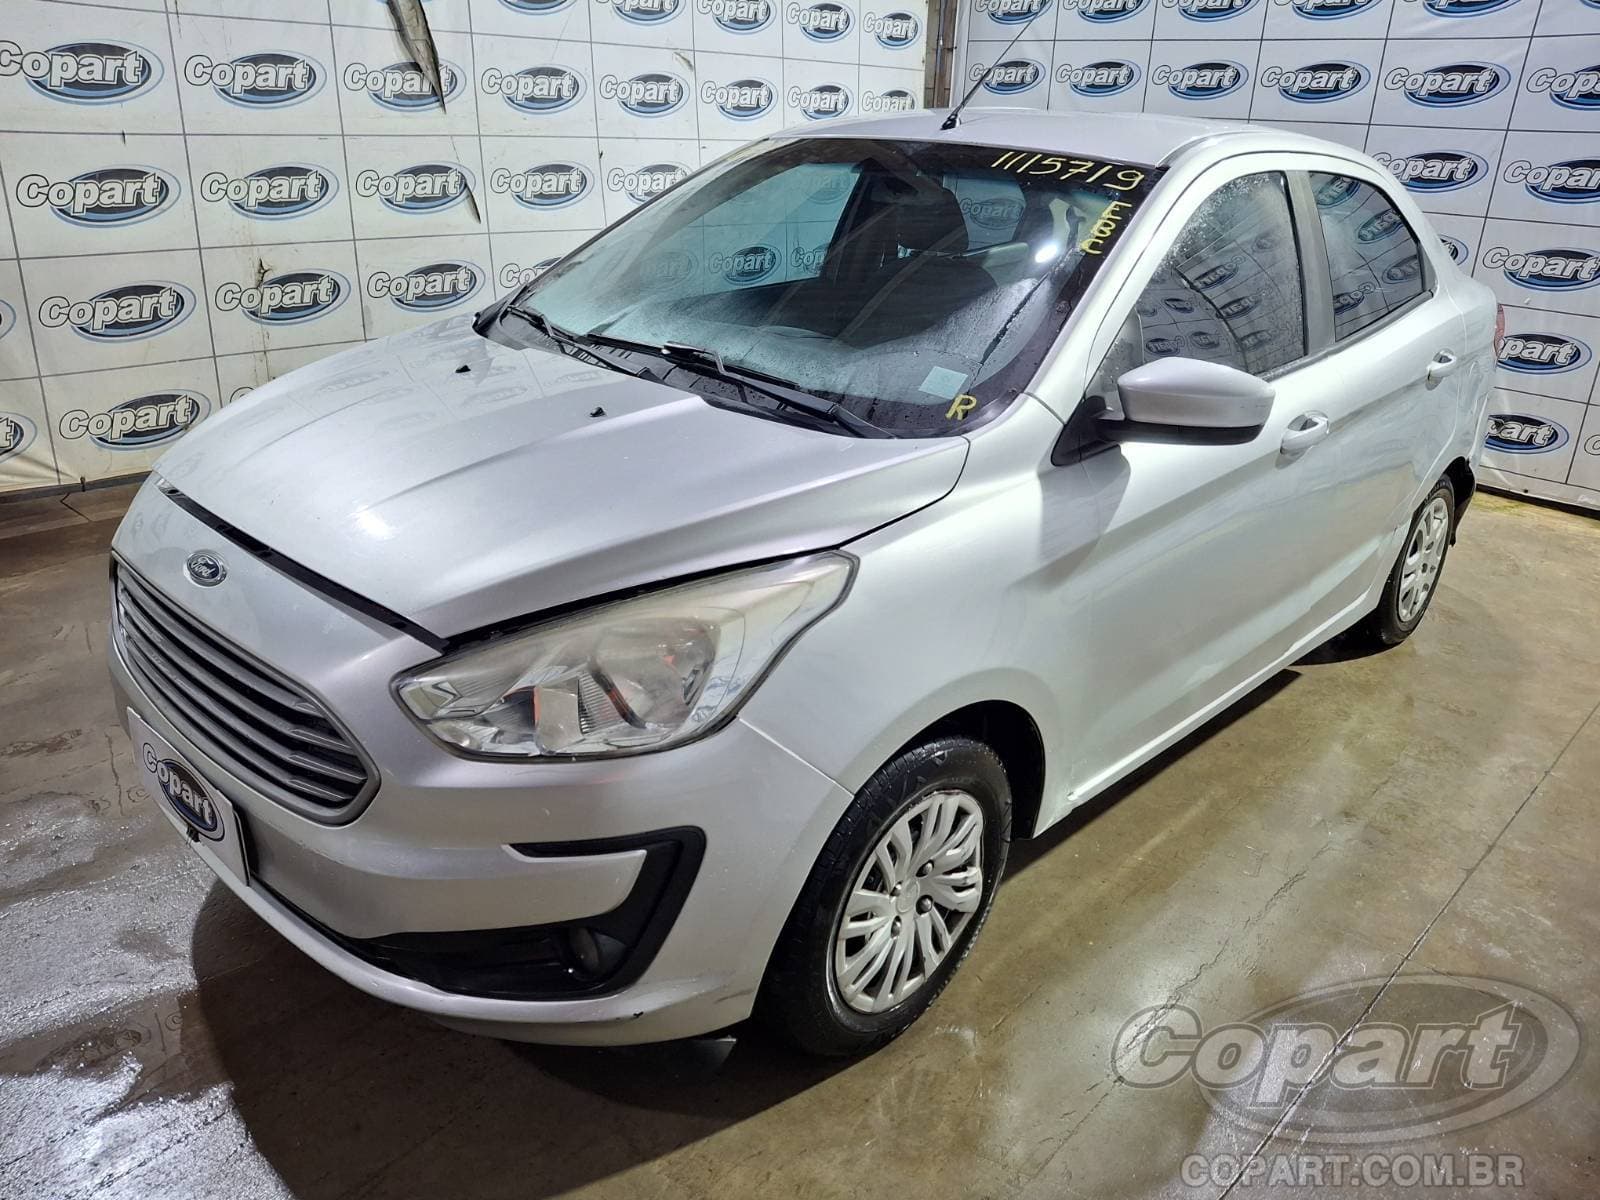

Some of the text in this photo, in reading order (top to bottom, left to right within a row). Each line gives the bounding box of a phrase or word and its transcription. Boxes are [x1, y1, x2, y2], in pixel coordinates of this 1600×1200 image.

[786, 3, 849, 33] Copart
[863, 11, 917, 40] Copart
[0, 40, 143, 89] Copart
[185, 55, 312, 96] Copart
[343, 62, 451, 99] Copart
[968, 60, 1039, 86] Copart
[1055, 63, 1132, 87] Copart
[1152, 63, 1242, 89] Copart
[1260, 65, 1358, 93] Copart
[481, 68, 577, 103] Copart
[600, 74, 682, 106] Copart
[701, 76, 773, 111] Copart
[1384, 66, 1498, 97] Copart
[787, 86, 848, 116] Copart
[862, 90, 915, 112] Copart
[16, 173, 161, 216] Copart
[200, 170, 325, 205] Copart
[356, 169, 464, 204] Copart
[490, 167, 587, 198] Copart
[959, 197, 1022, 219] Copart
[709, 248, 773, 279] Copart
[1482, 246, 1600, 281] Copart
[214, 273, 336, 316] Copart
[367, 264, 473, 299] Copart
[38, 287, 179, 332] Copart
[58, 393, 195, 441] Copart
[945, 394, 978, 421] R
[190, 556, 217, 577] Ford
[142, 742, 215, 826] Copart
